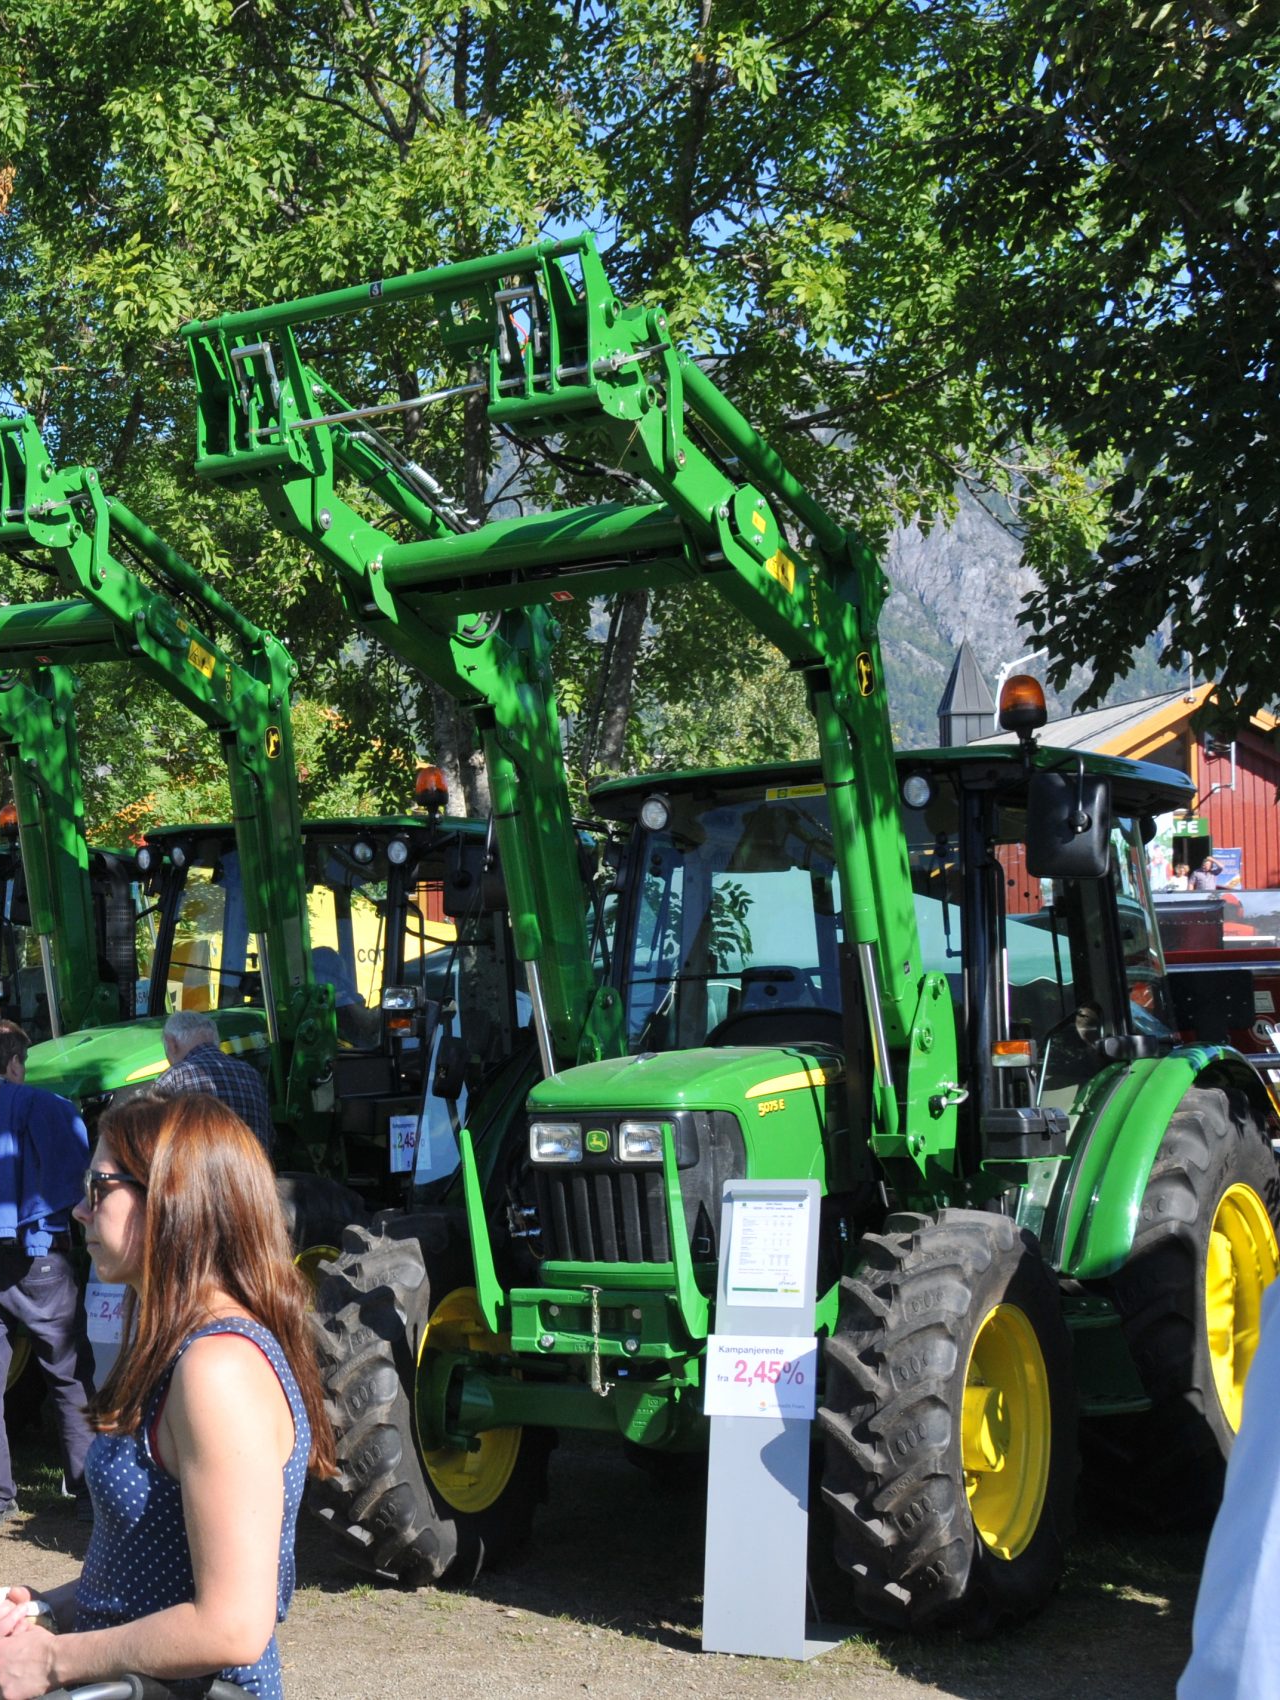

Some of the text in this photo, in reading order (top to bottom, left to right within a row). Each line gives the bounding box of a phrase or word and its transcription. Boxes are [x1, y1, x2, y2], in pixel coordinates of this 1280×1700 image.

[718, 1345, 784, 1356] Kampanjerente
[717, 1359, 805, 1387] fra 2,45%
